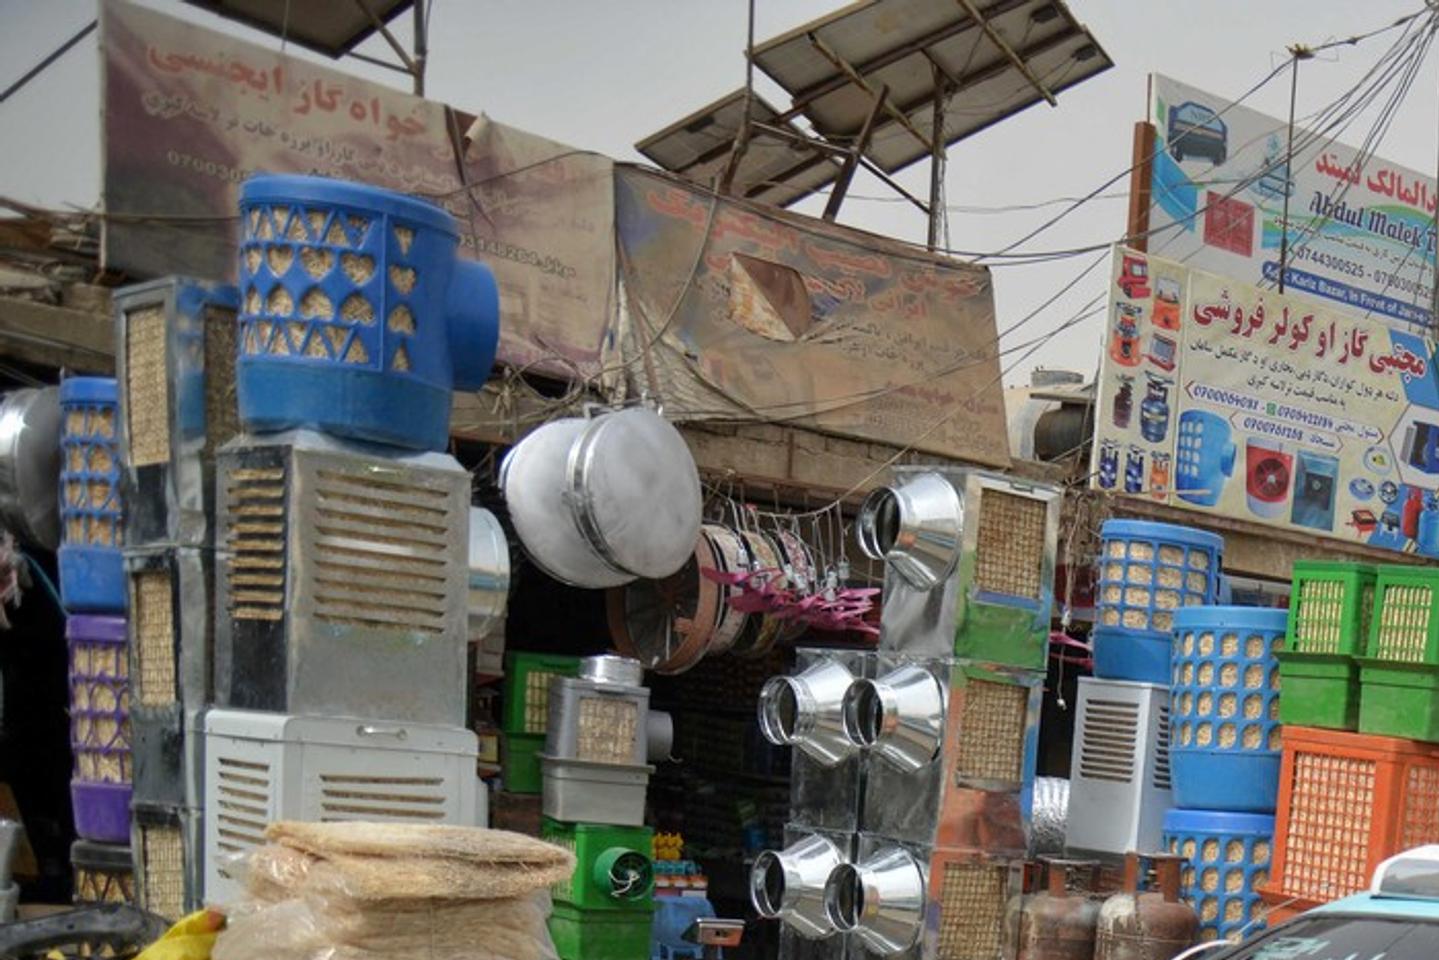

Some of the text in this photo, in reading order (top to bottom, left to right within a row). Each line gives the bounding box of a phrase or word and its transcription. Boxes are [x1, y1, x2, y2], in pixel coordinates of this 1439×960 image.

[1308, 190, 1365, 228] Abdul
[1368, 211, 1423, 249] Malek
[1193, 287, 1265, 339] فروشی
[1268, 305, 1315, 350] کولر
[1315, 319, 1337, 358] او
[1338, 326, 1370, 365] گاز
